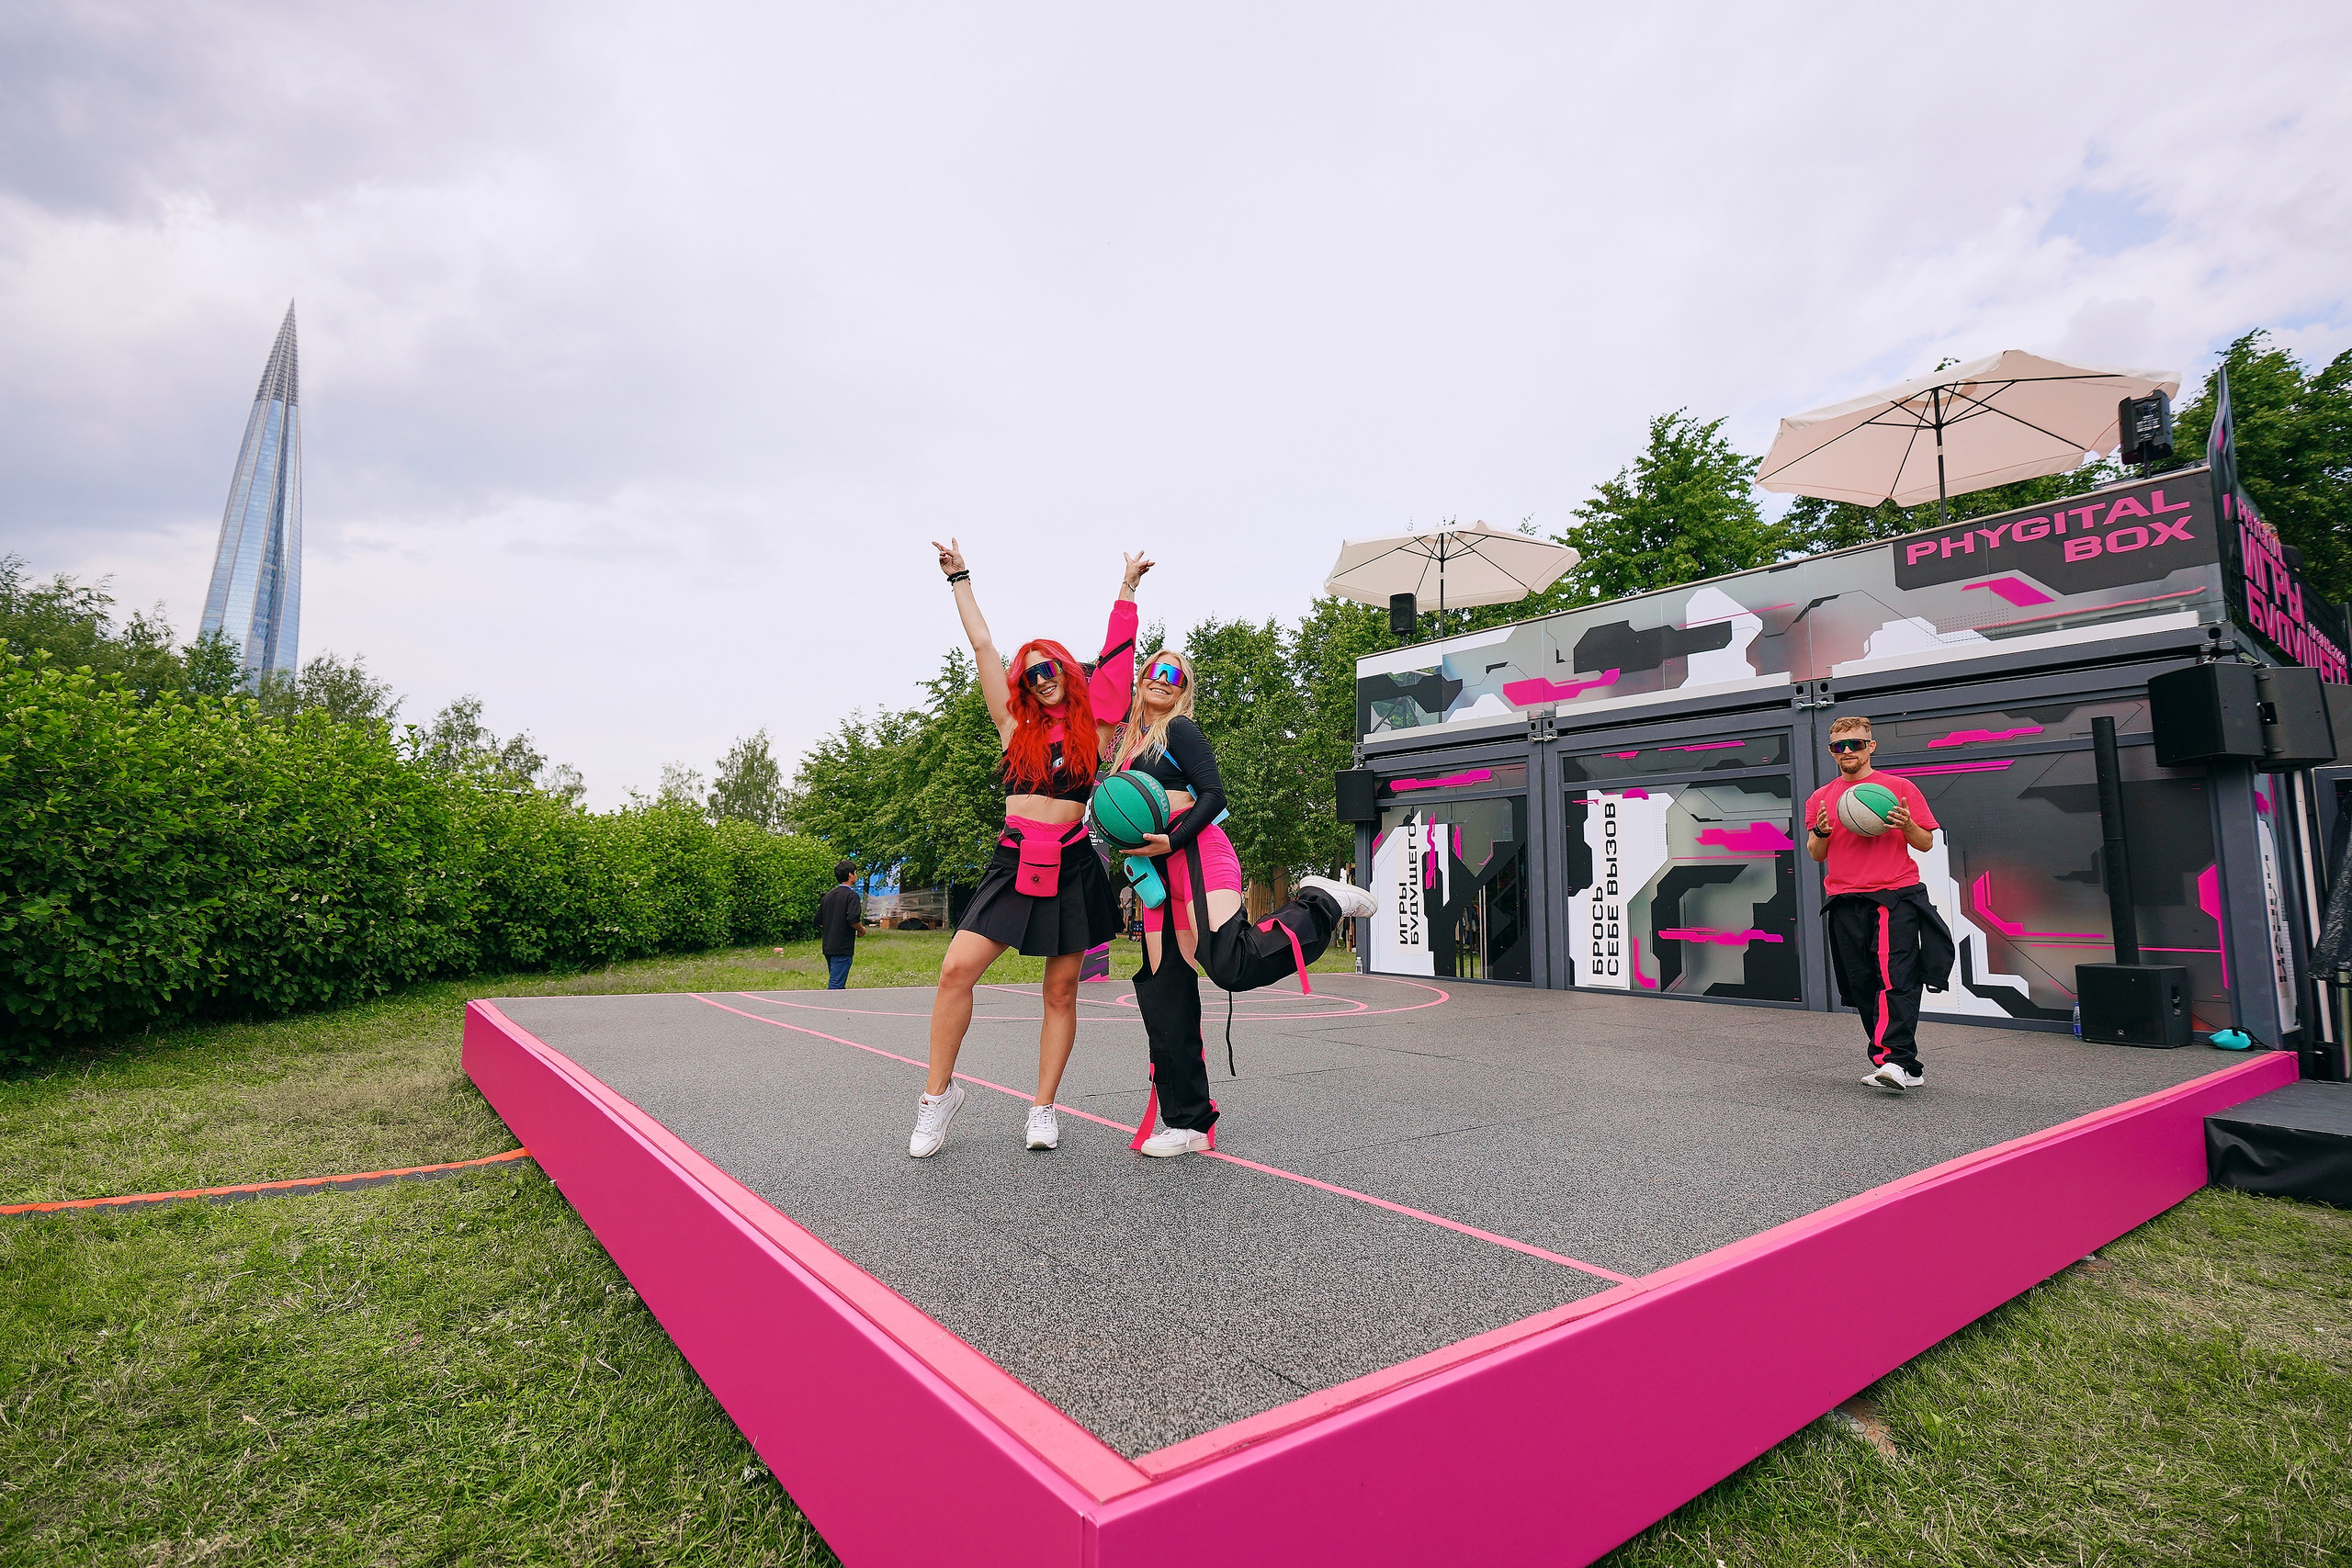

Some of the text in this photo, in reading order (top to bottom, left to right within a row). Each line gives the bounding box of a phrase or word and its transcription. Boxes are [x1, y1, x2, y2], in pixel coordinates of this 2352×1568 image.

[1907, 491, 2190, 566] PHYGITAL
[2064, 516, 2195, 563] BOX
[2239, 523, 2306, 629] ИГРЫ
[1135, 772, 1169, 813] molten
[1398, 882, 1408, 945] ИГРЫ
[1408, 822, 1419, 945] БУДУЩЕГО
[1604, 802, 1619, 976] СЕБЕ ВЫЗОВ
[1591, 886, 1604, 976] БРОСЬ
